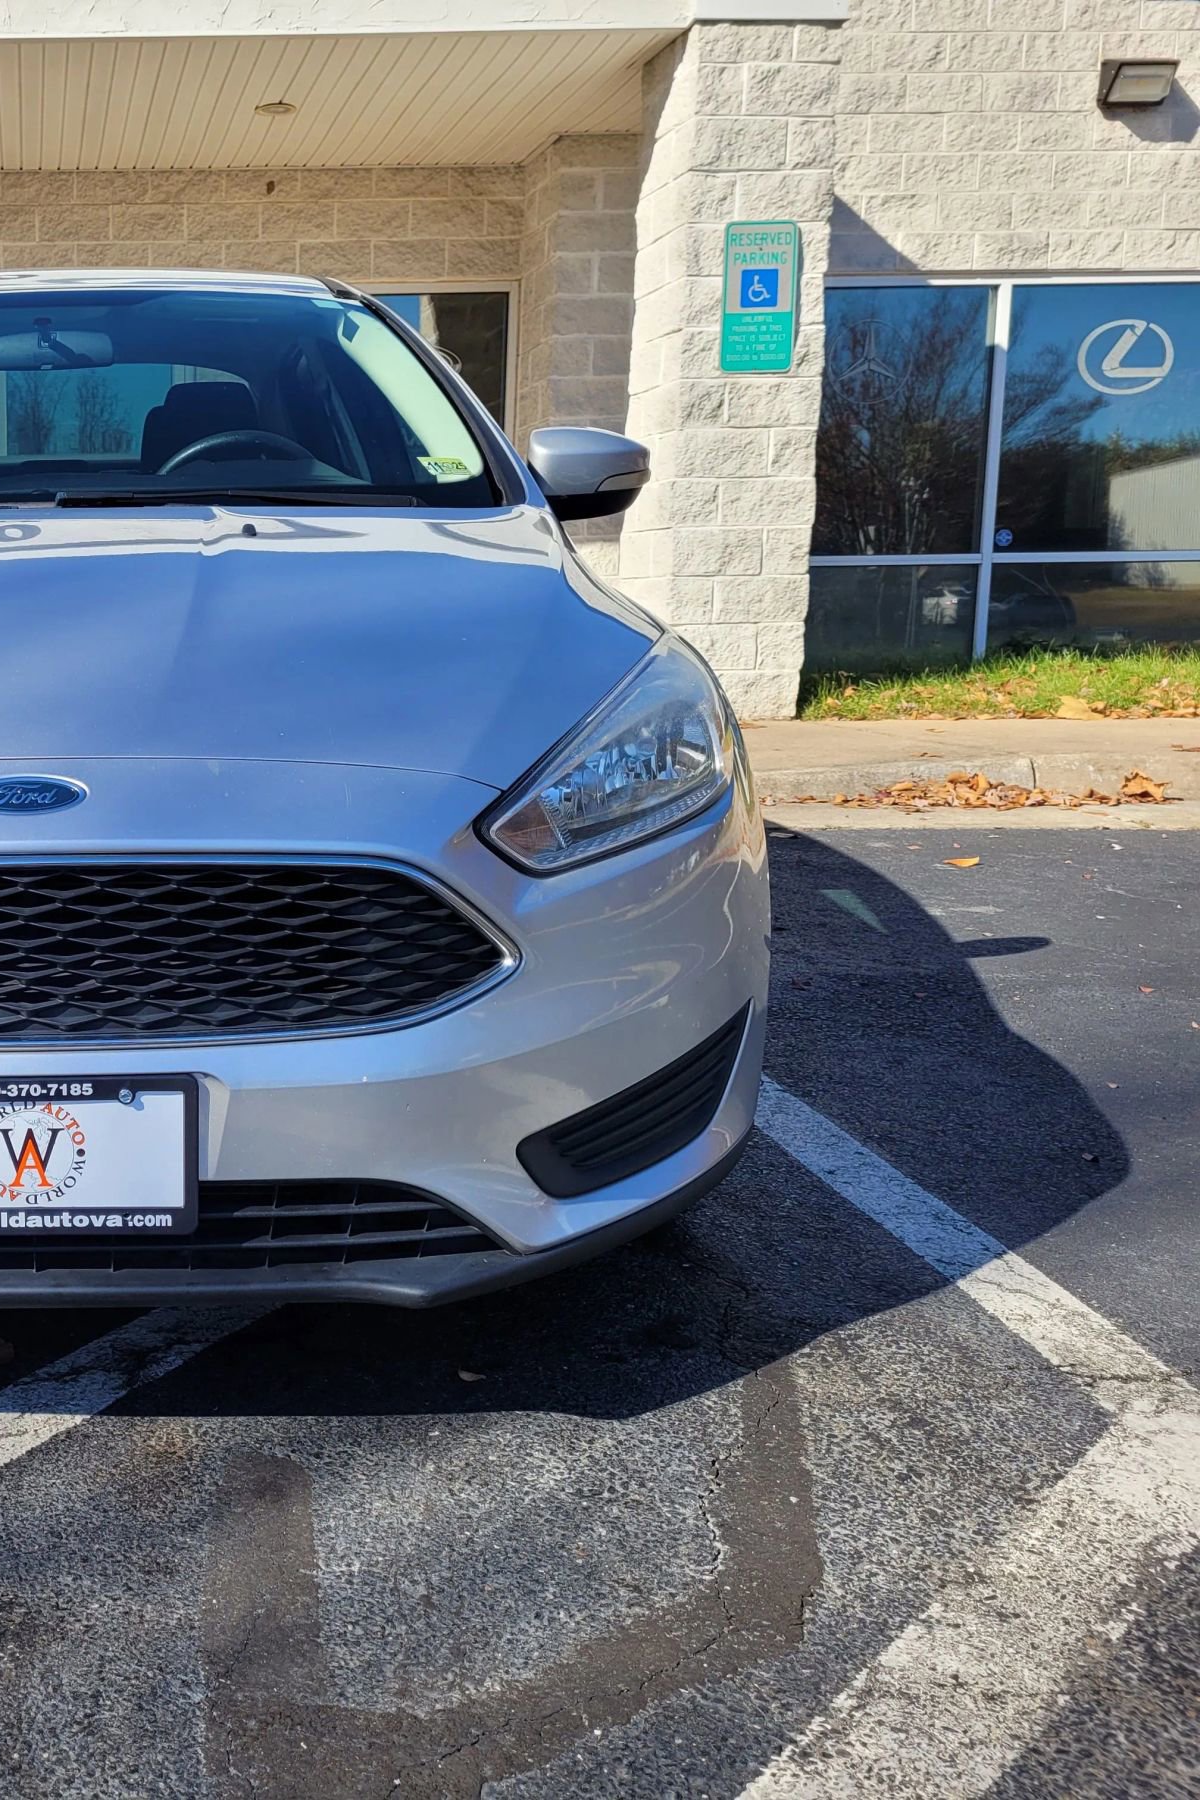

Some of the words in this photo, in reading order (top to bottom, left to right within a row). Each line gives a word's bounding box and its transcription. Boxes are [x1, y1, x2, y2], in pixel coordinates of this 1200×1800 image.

[730, 232, 792, 247] RESERVED
[733, 251, 788, 266] PARKING
[427, 461, 445, 473] 11
[451, 461, 467, 471] 25
[40, 1102, 85, 1146] AUTO
[26, 1160, 86, 1205] WORLD
